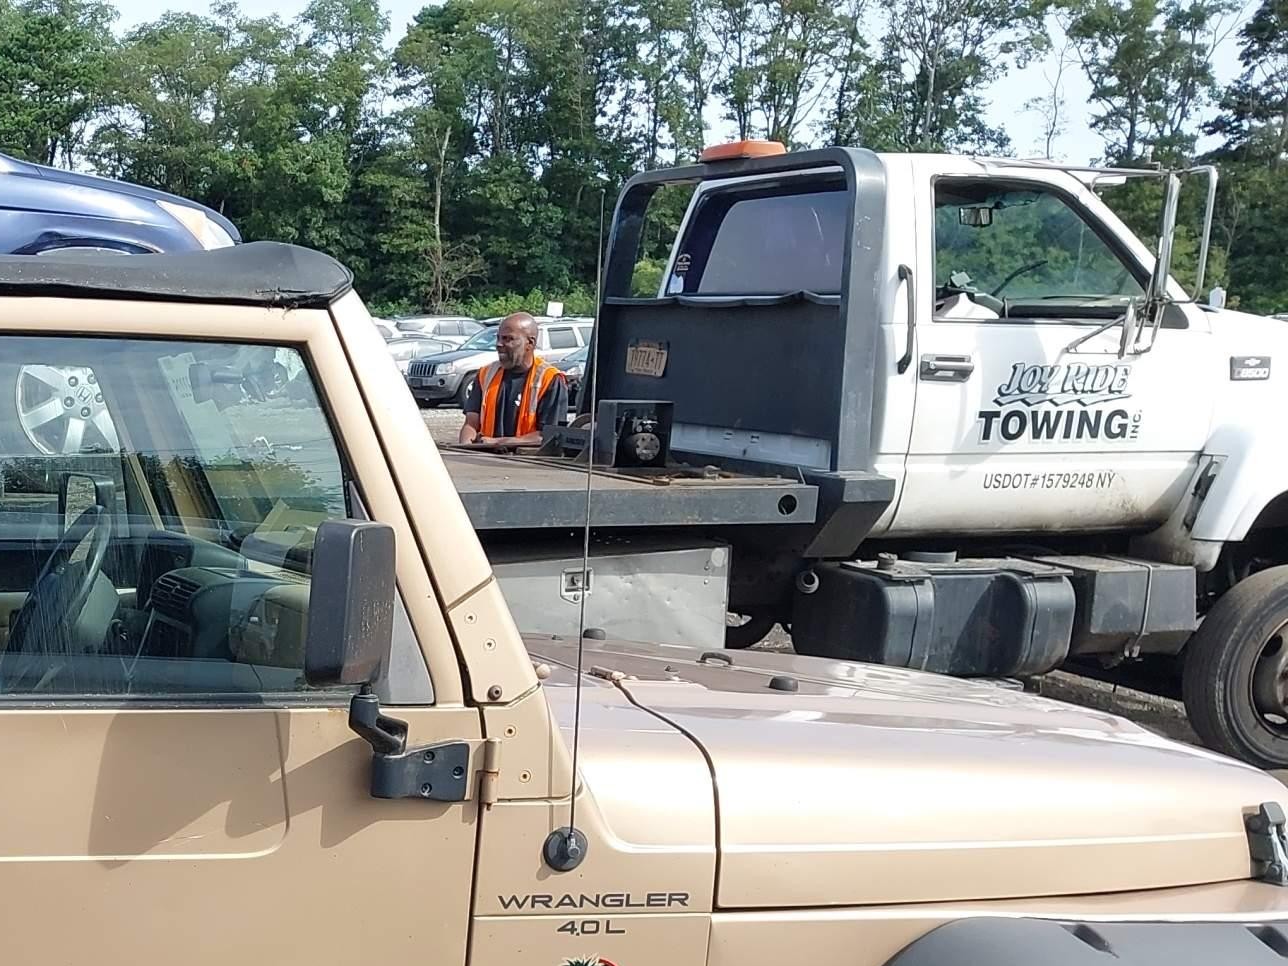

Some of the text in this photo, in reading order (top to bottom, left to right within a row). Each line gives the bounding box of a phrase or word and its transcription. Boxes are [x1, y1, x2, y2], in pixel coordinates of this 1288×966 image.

[998, 362, 1132, 396] JOY RIDE
[978, 409, 1143, 441] TOWING INC.
[983, 472, 1115, 489] USDOT#1579248 NY
[498, 893, 689, 910] WRANGLER
